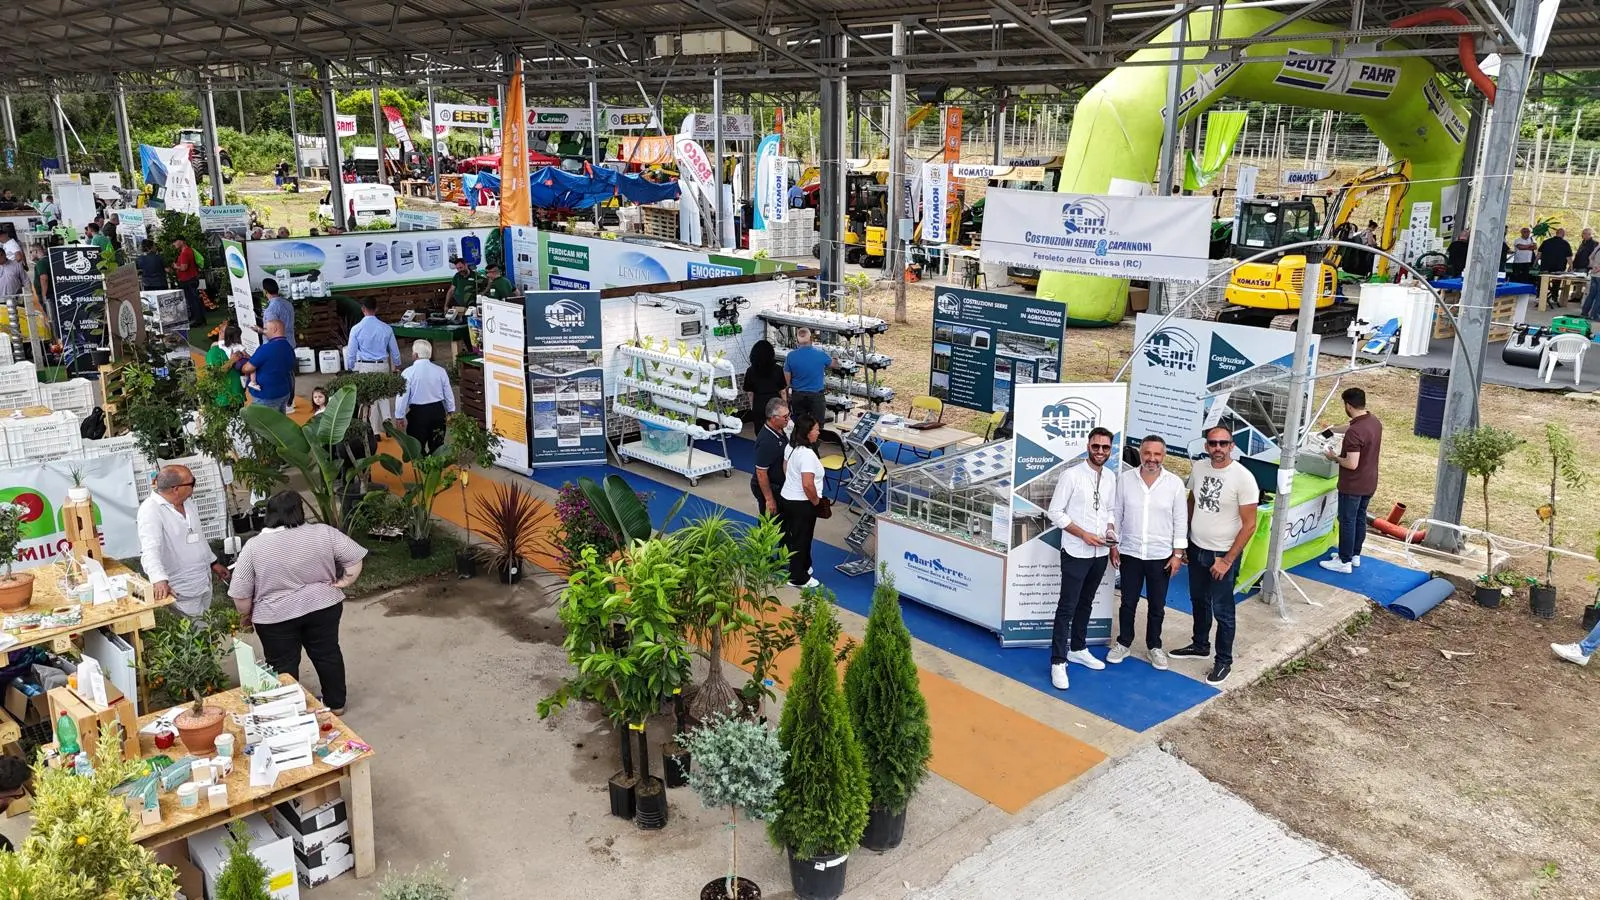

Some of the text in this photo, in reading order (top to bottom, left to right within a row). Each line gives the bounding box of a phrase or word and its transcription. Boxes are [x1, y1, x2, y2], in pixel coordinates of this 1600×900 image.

[1284, 51, 1397, 84] DEUTZ FAHR
[336, 121, 355, 132] SAME
[1009, 158, 1041, 168] KOMATSU
[958, 166, 995, 178] KOMATSU
[1287, 171, 1319, 184] KOMATSU
[1025, 231, 1152, 256] COSTRUZIONI SERRE & CAPANNONI
[548, 247, 588, 260] FERDICAM NPK
[1033, 252, 1142, 269] Feroleto della Chiesa (RC)
[618, 265, 650, 281] LENTINI
[690, 265, 738, 277] EMOGREEN
[1236, 277, 1271, 287] KOMATSU
[1025, 307, 1062, 317] INNOVAZIONE
[1027, 314, 1062, 324] AGRICOLTURA
[1211, 354, 1246, 366] Costruzioni
[1218, 362, 1237, 372] Serre
[1017, 455, 1055, 464] Costruzioni
[1025, 463, 1046, 471] Serre
